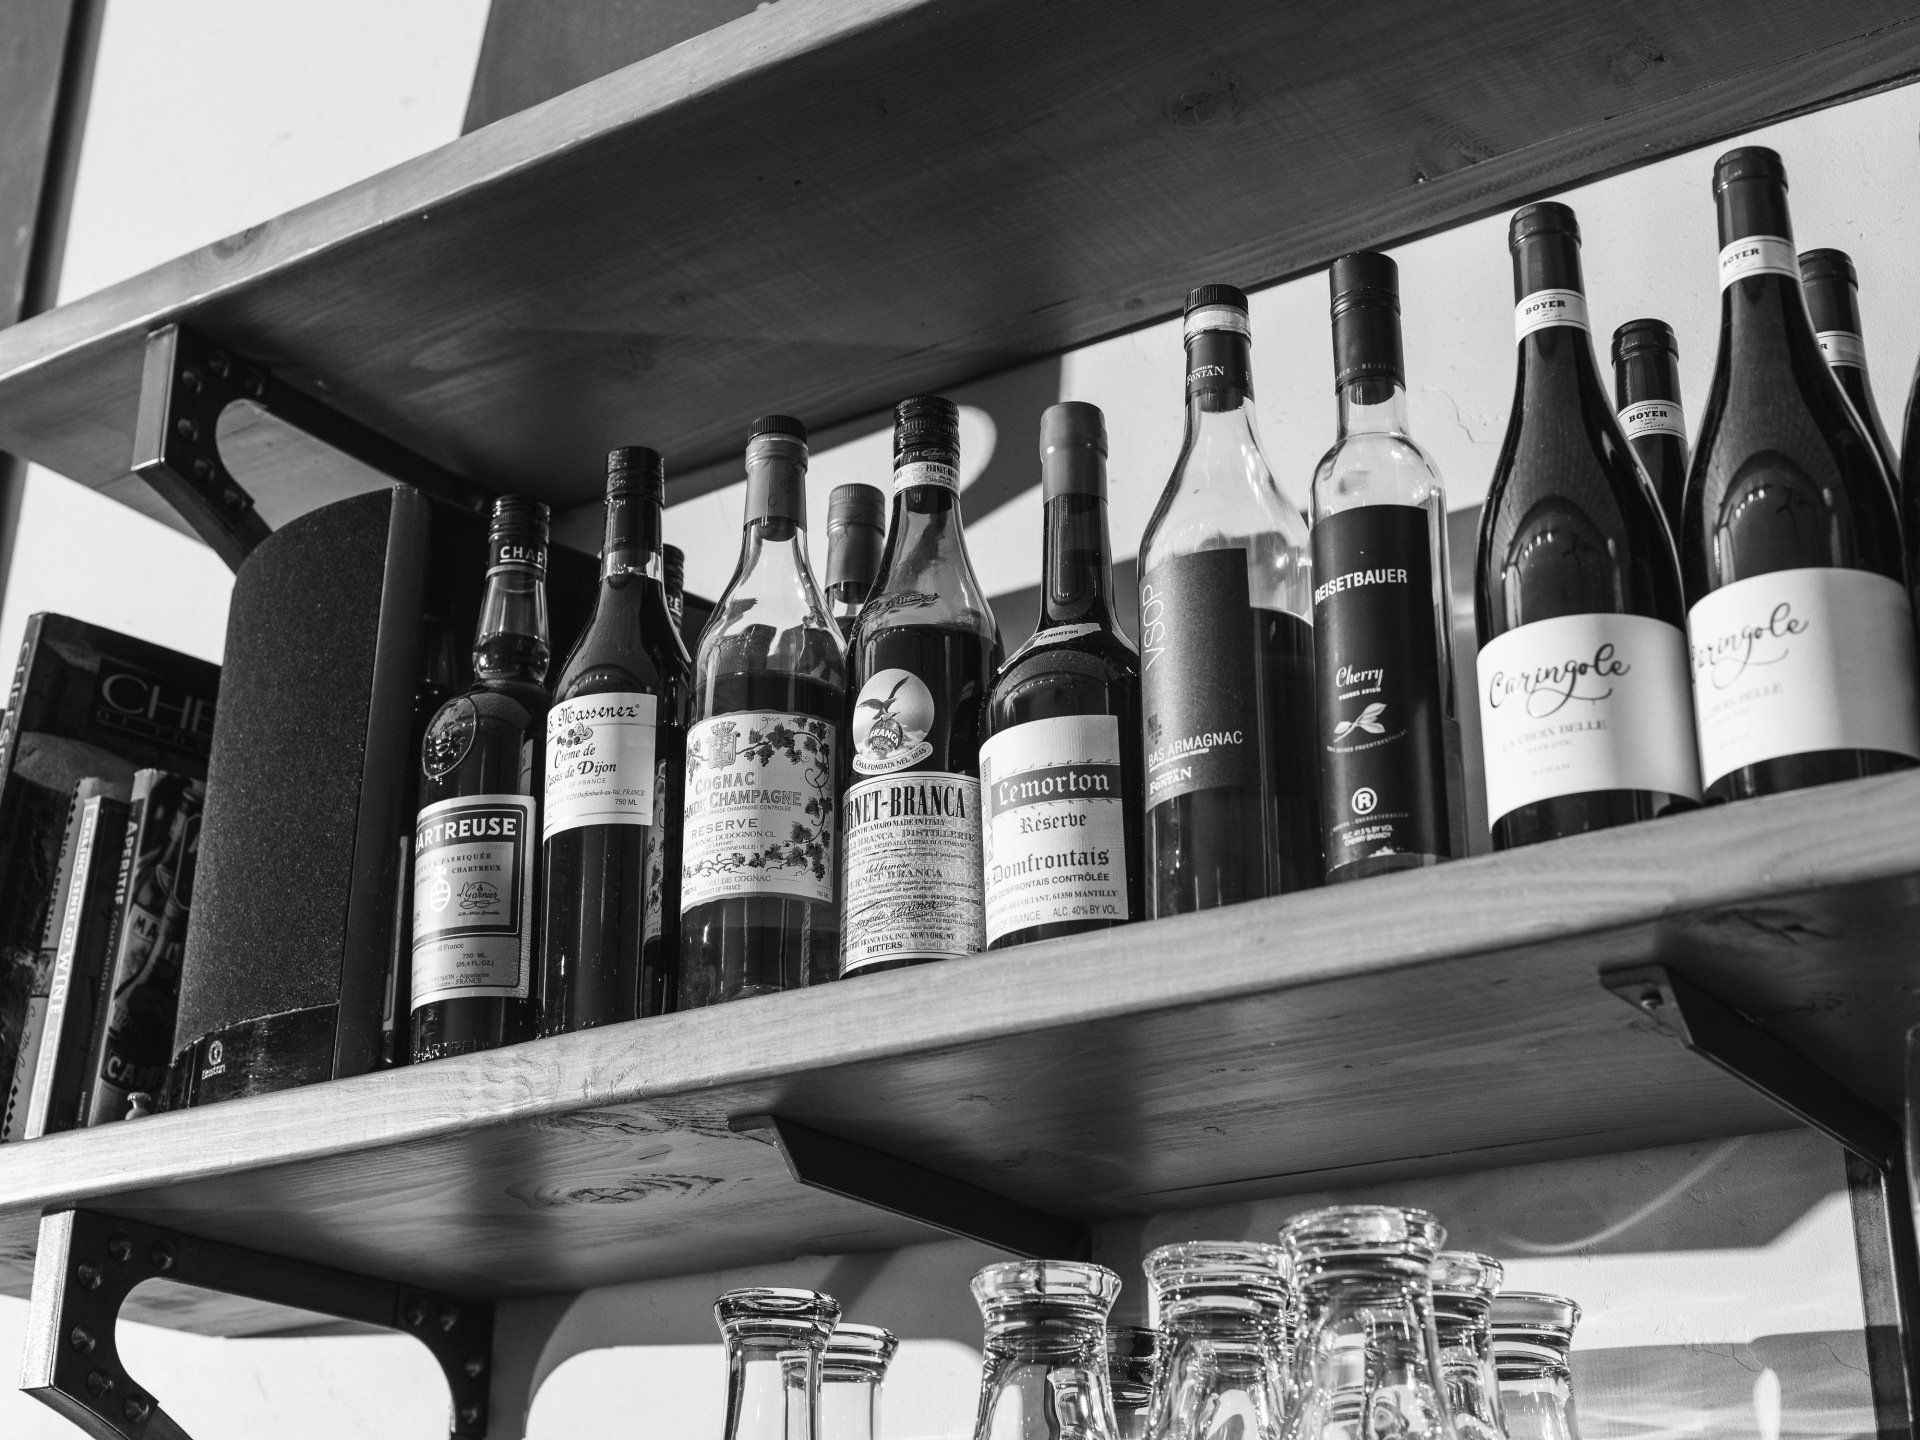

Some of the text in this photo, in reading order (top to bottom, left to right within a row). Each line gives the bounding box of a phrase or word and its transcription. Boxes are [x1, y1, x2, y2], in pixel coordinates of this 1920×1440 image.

[1526, 300, 1566, 315] BOYER
[1187, 366, 1224, 387] FONTAN
[1629, 411, 1668, 423] BOYER
[1314, 568, 1408, 606] REISETBAUER
[1142, 584, 1165, 671] VSOP
[1335, 664, 1384, 689] Cherry
[1489, 643, 1631, 719] Caringole
[583, 743, 596, 756] de
[1148, 730, 1243, 768] BAS ARMAGNAC
[565, 765, 574, 778] de
[577, 760, 617, 777] Dijon
[867, 762, 895, 770] FONDATA
[695, 772, 755, 795] COGNAC
[1000, 771, 1110, 806] Lemorton
[1150, 766, 1192, 795] FONTAN
[710, 790, 802, 808] CHAMPAGNE
[692, 818, 758, 840] RESERVE
[1020, 812, 1087, 834] Réserve
[902, 829, 975, 842] DISTILLERIE
[114, 821, 138, 905] APERITIF
[992, 846, 1109, 885] Domfrontais
[1052, 872, 1110, 884] CONTRÔLÉE
[1074, 890, 1118, 898] MANTILLY
[49, 815, 94, 1016] MAKING SENSE OF WINE
[1089, 905, 1100, 914] BY
[100, 910, 119, 991] COMPANION
[867, 942, 903, 953] BITTERS
